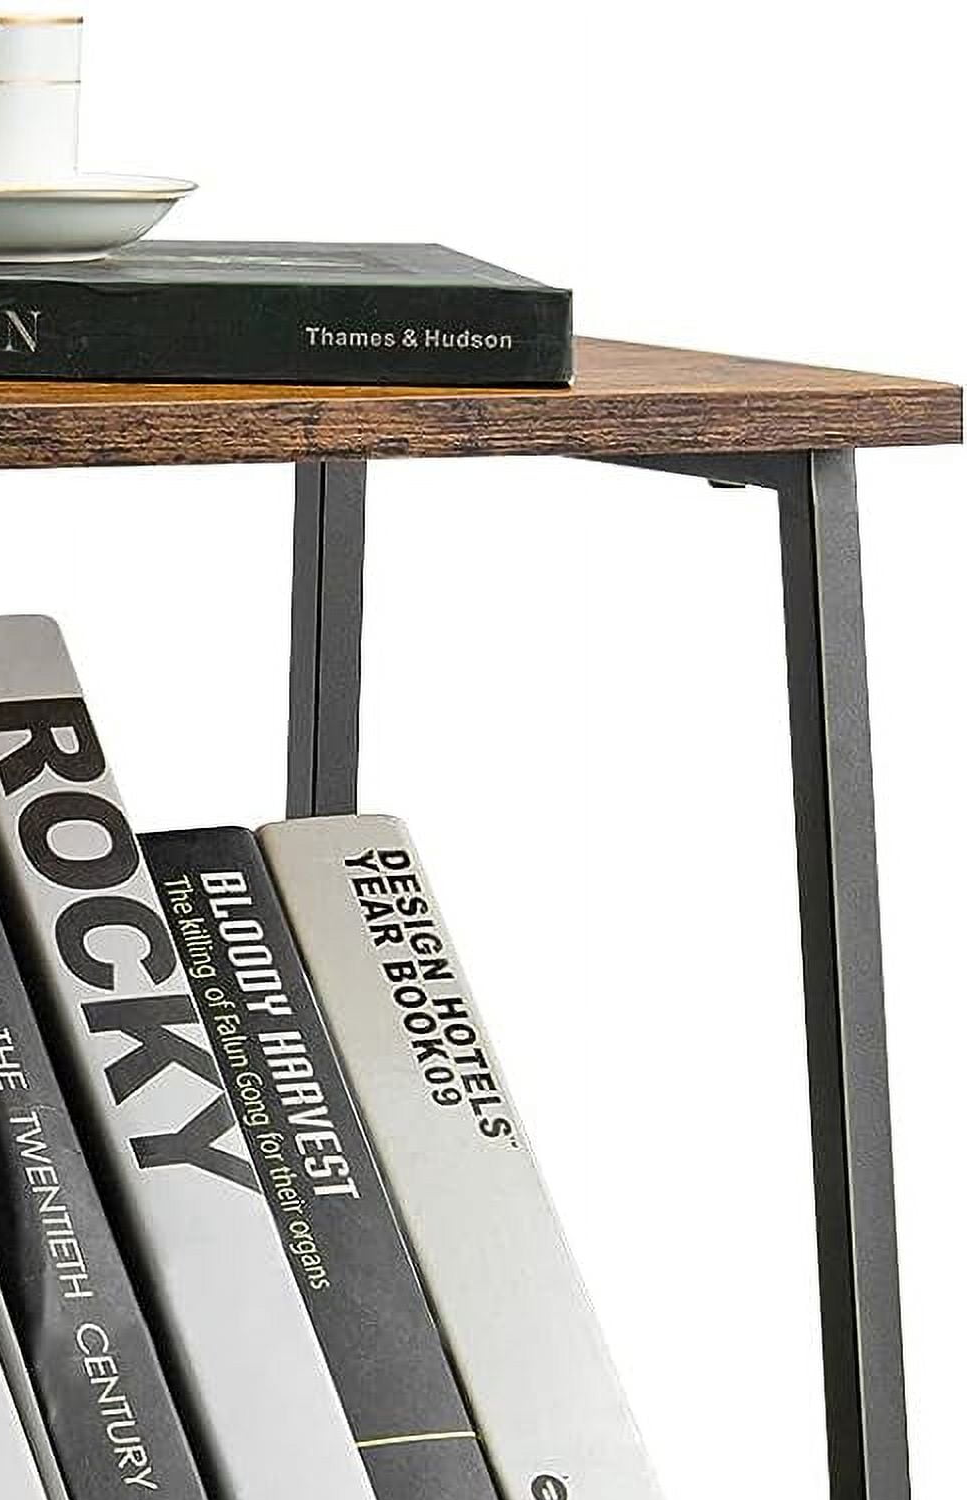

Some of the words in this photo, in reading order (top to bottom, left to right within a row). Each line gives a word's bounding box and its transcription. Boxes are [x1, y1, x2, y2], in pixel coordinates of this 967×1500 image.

[305, 326, 394, 349] Thames
[402, 328, 419, 349] &
[426, 328, 513, 350] Hudson
[163, 874, 193, 915] The
[344, 848, 404, 947] YEAR
[377, 848, 455, 981] DESIGN
[179, 917, 216, 979] killing
[205, 987, 235, 1013] of
[200, 869, 293, 1021] BLOODY
[259, 1028, 359, 1200] HARVEST
[213, 1012, 250, 1069] Falun
[236, 1072, 270, 1127] Gong
[257, 1131, 284, 1160] for
[270, 1160, 305, 1214] their
[288, 1220, 330, 1290] organs
[10, 1110, 93, 1299] TWENTIETH
[75, 1323, 157, 1492] CENTURY
